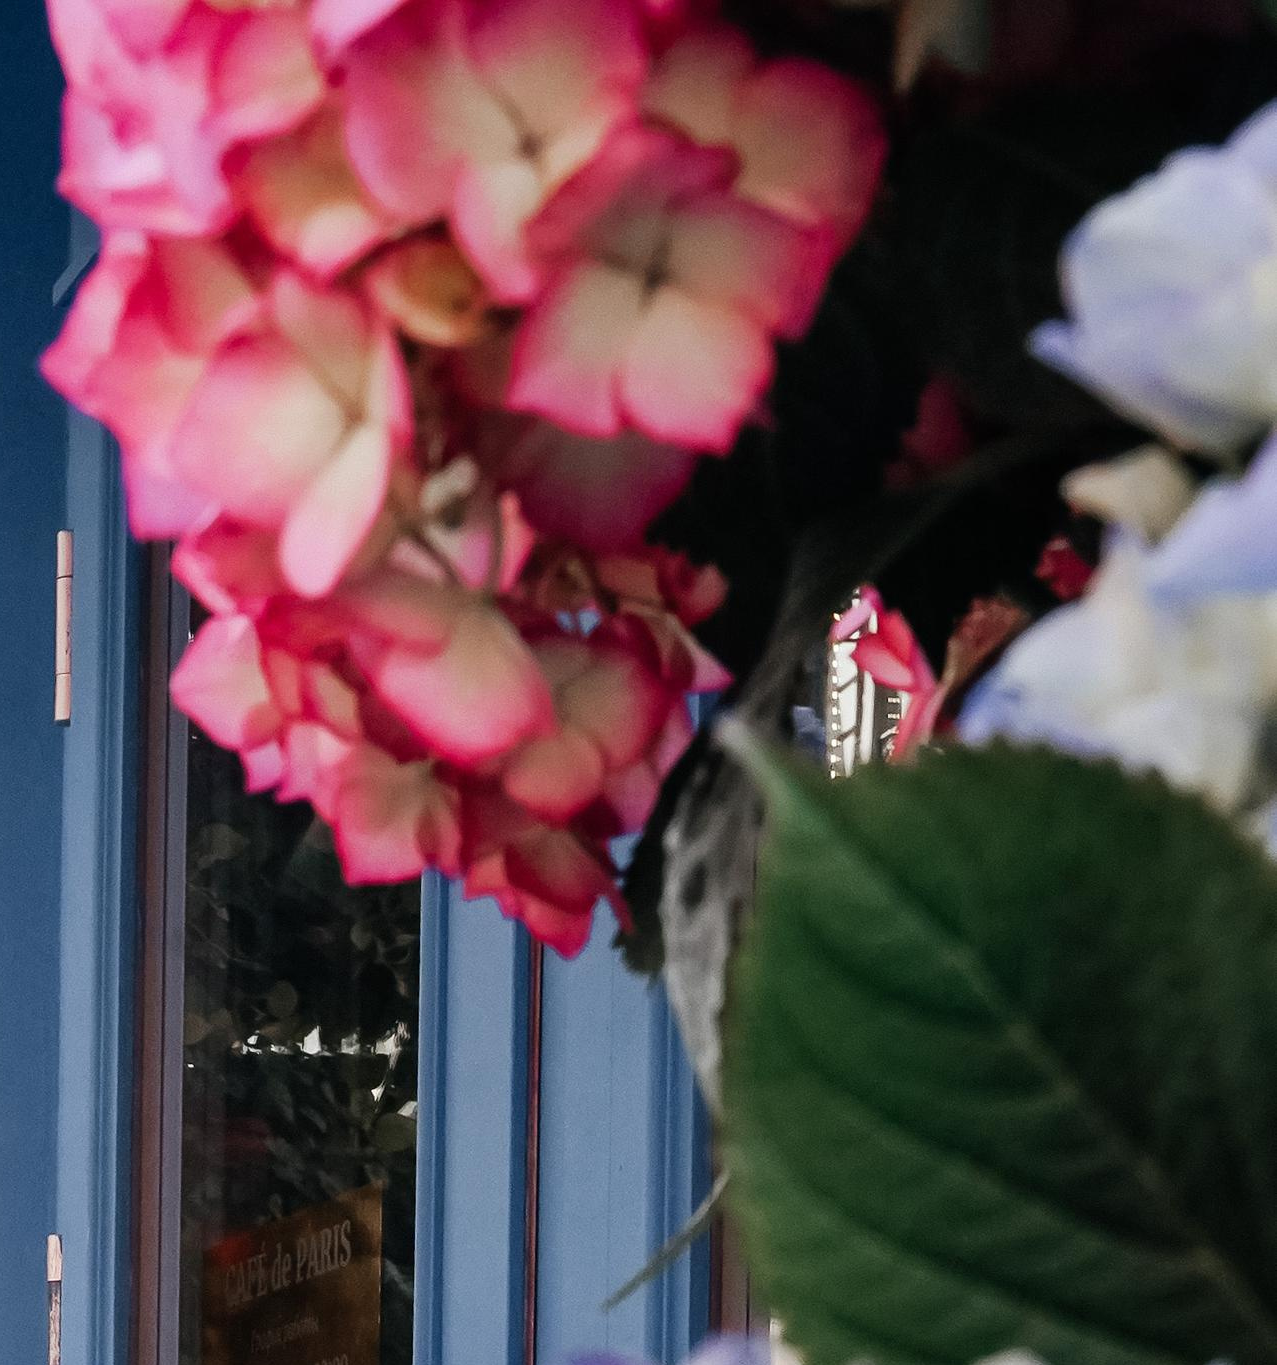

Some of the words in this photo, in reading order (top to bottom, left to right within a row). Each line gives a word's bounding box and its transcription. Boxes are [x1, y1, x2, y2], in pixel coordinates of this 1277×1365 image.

[226, 1241, 268, 1306] CAFÉ
[271, 1242, 291, 1292] de
[296, 1219, 352, 1284] PARIS
